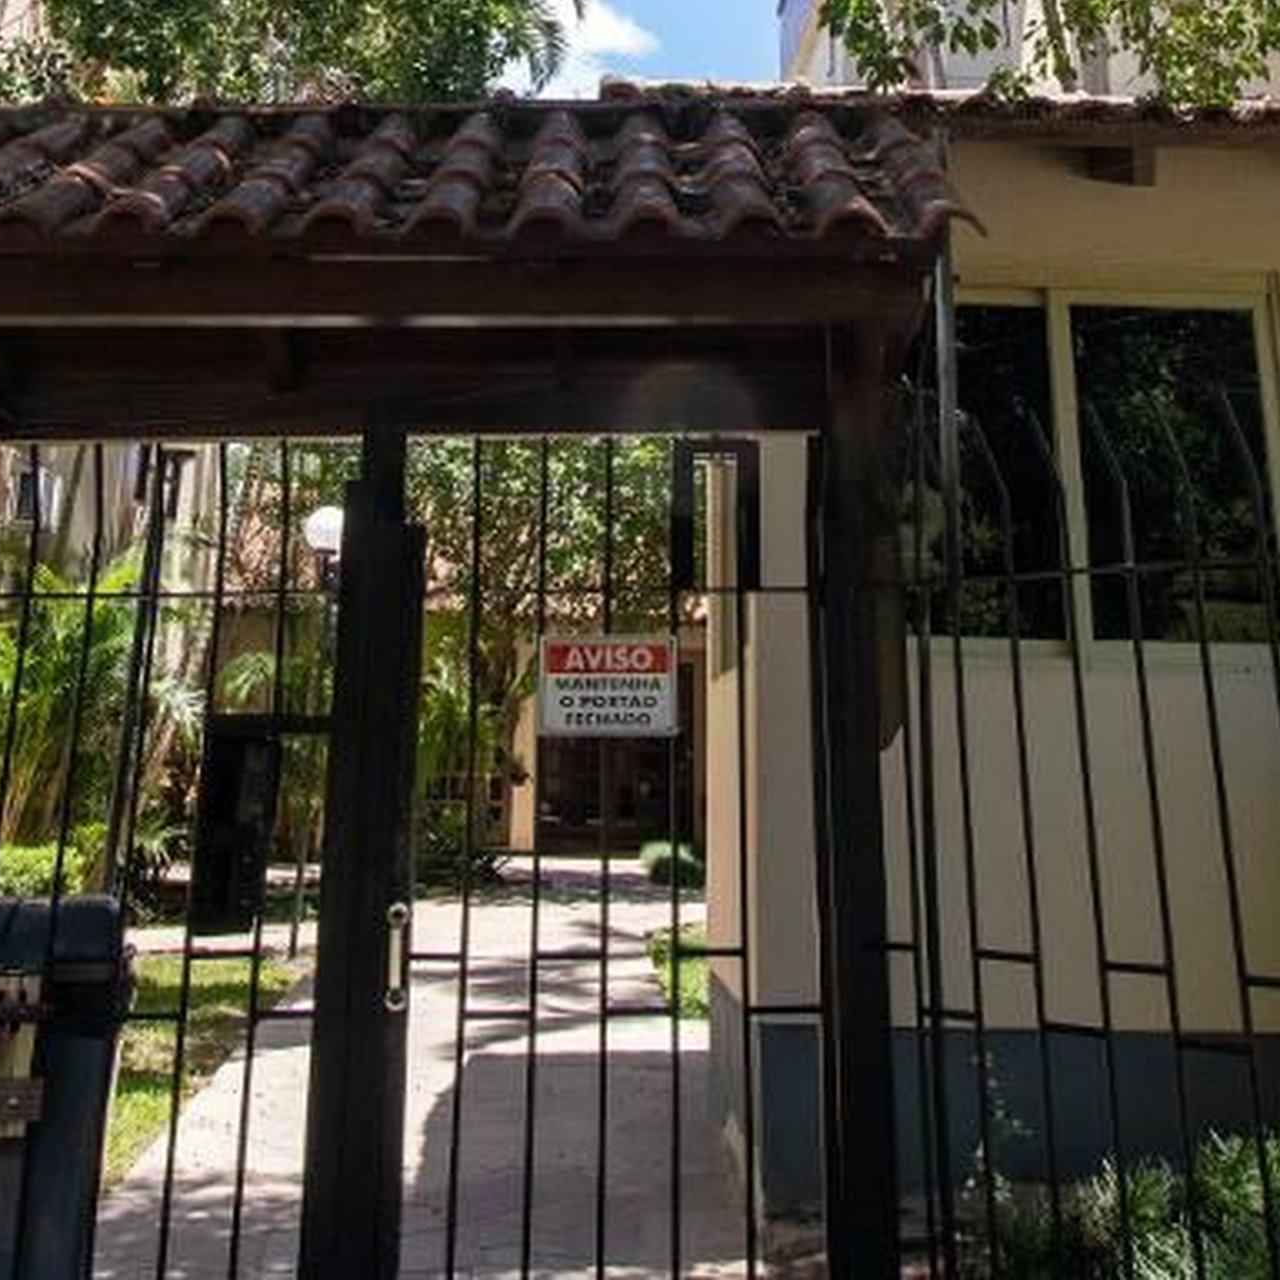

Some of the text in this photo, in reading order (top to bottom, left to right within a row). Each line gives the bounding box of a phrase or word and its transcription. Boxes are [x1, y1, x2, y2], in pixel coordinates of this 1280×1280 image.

[565, 646, 653, 670] AVISO
[555, 677, 662, 692] MANTENHA
[559, 695, 574, 708] O
[565, 713, 652, 726] FECHADO
